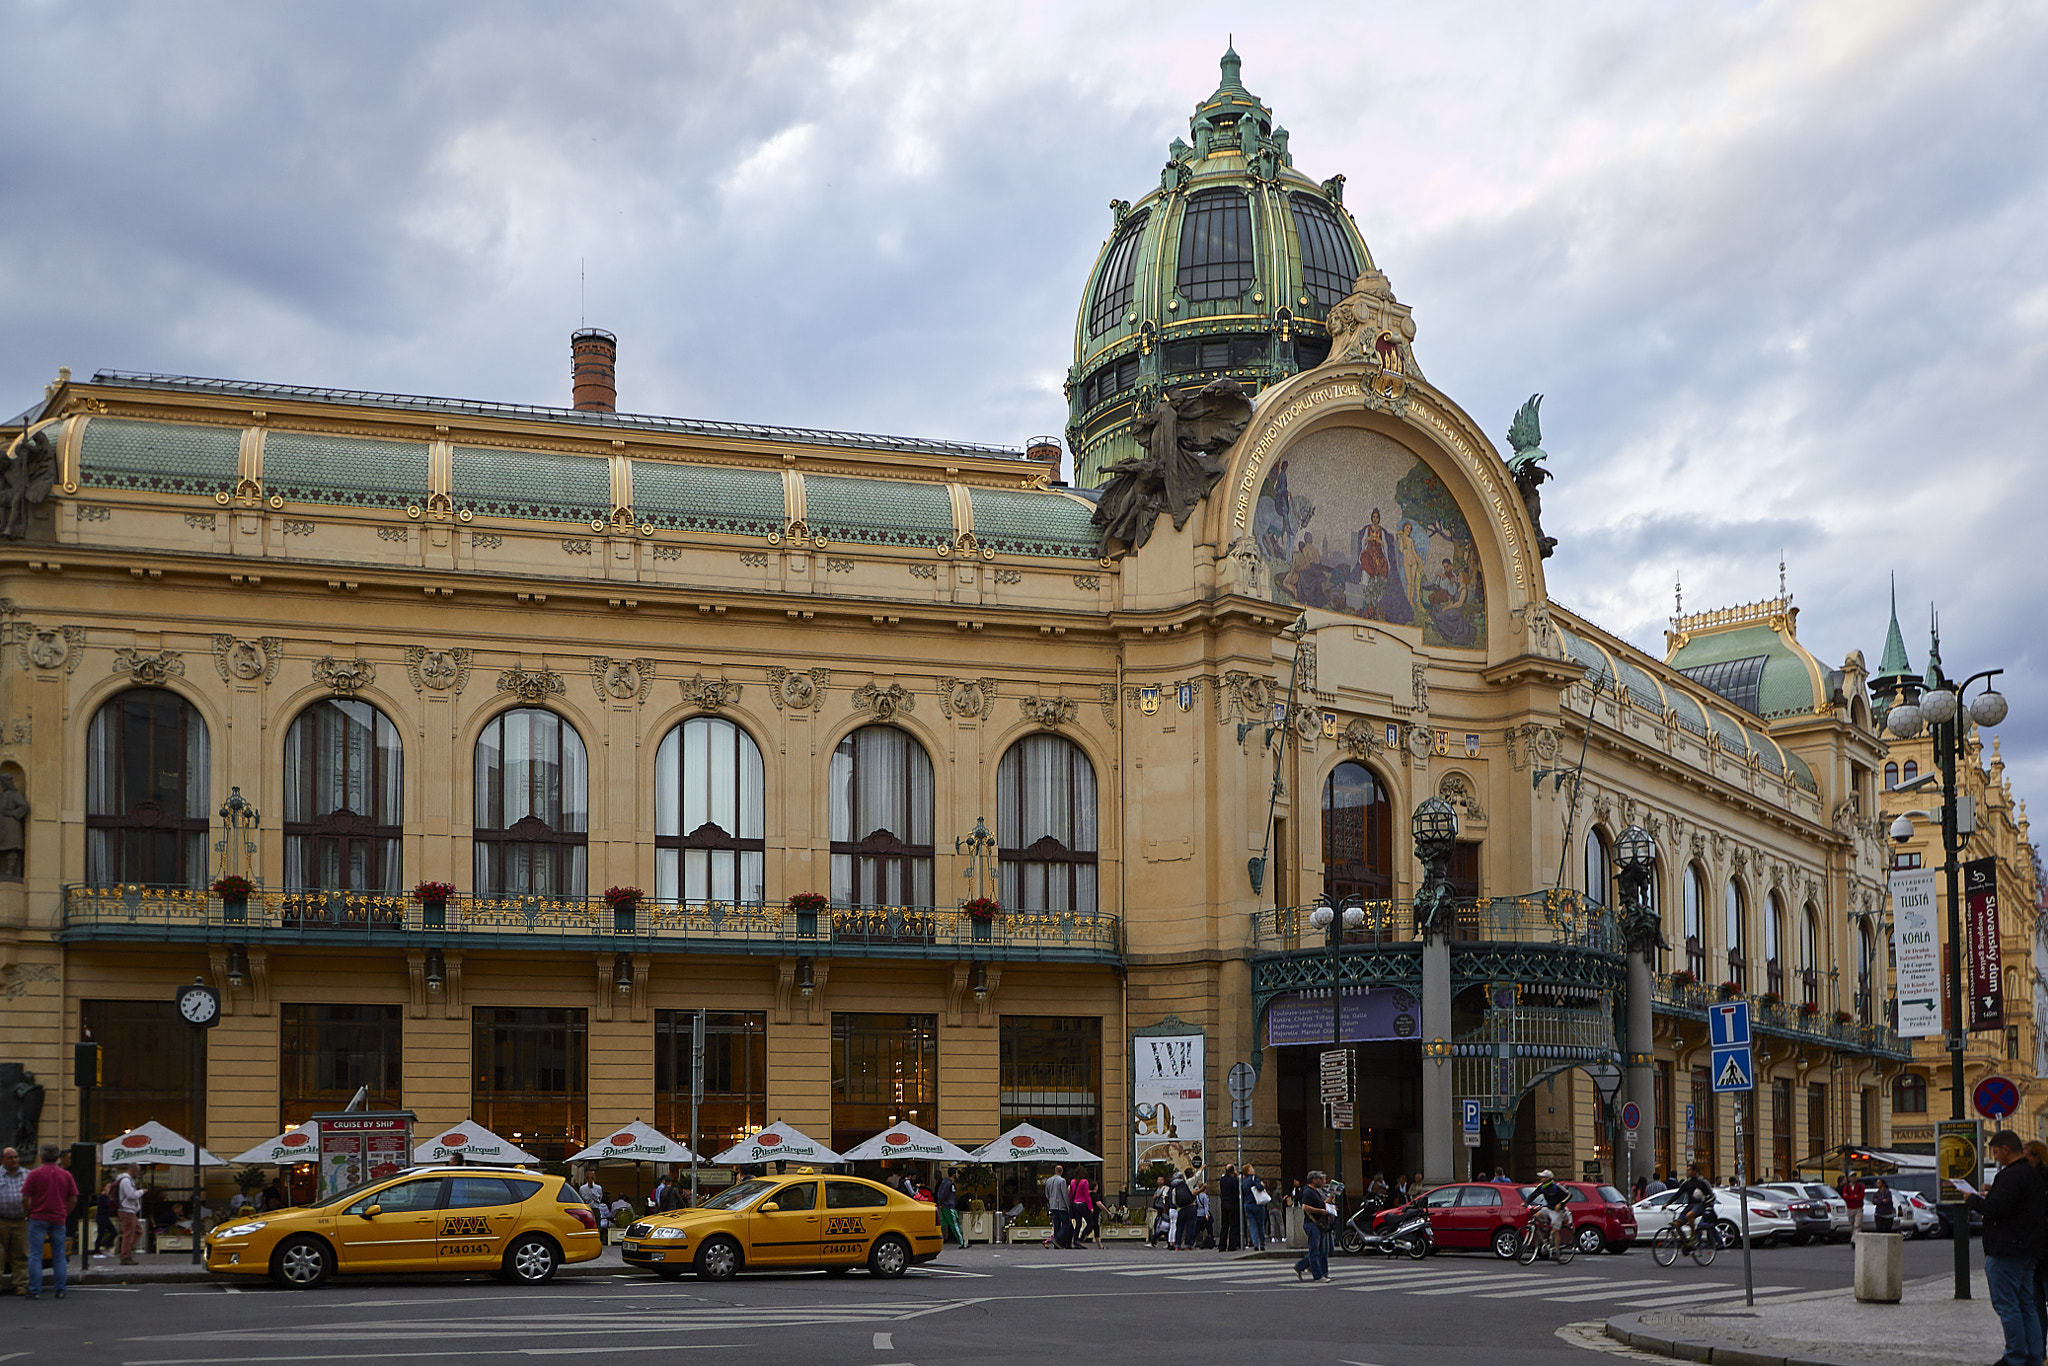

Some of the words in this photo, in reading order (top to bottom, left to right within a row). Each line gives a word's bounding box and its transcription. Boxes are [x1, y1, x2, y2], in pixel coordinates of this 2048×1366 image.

[1901, 892, 1929, 908] TLUSTÁ
[1977, 911, 1986, 950] shopping
[1985, 895, 1998, 961] Slovanský
[1902, 931, 1931, 945] KOALA
[1978, 951, 1986, 980] gallery
[1989, 963, 1999, 993] dům
[1467, 1104, 1477, 1122] P
[333, 1121, 361, 1129] CRUISE
[375, 1120, 395, 1128] SHIP
[112, 1148, 148, 1161] Pilsner
[148, 1146, 186, 1157] Urquell
[271, 1146, 308, 1160] Pilsner
[432, 1146, 467, 1159] Pilsner
[467, 1145, 501, 1156] Urquell
[601, 1146, 635, 1156] Pilsner
[634, 1144, 667, 1155] Urquell
[751, 1146, 782, 1160] Pilsner
[782, 1145, 815, 1156] Urquell
[881, 1145, 911, 1157] Pilsner
[911, 1144, 945, 1154] Urquell
[1009, 1147, 1038, 1160] Pilsner
[1037, 1146, 1070, 1156] Urquell
[440, 1216, 492, 1236] AAA
[825, 1216, 867, 1235] AAA
